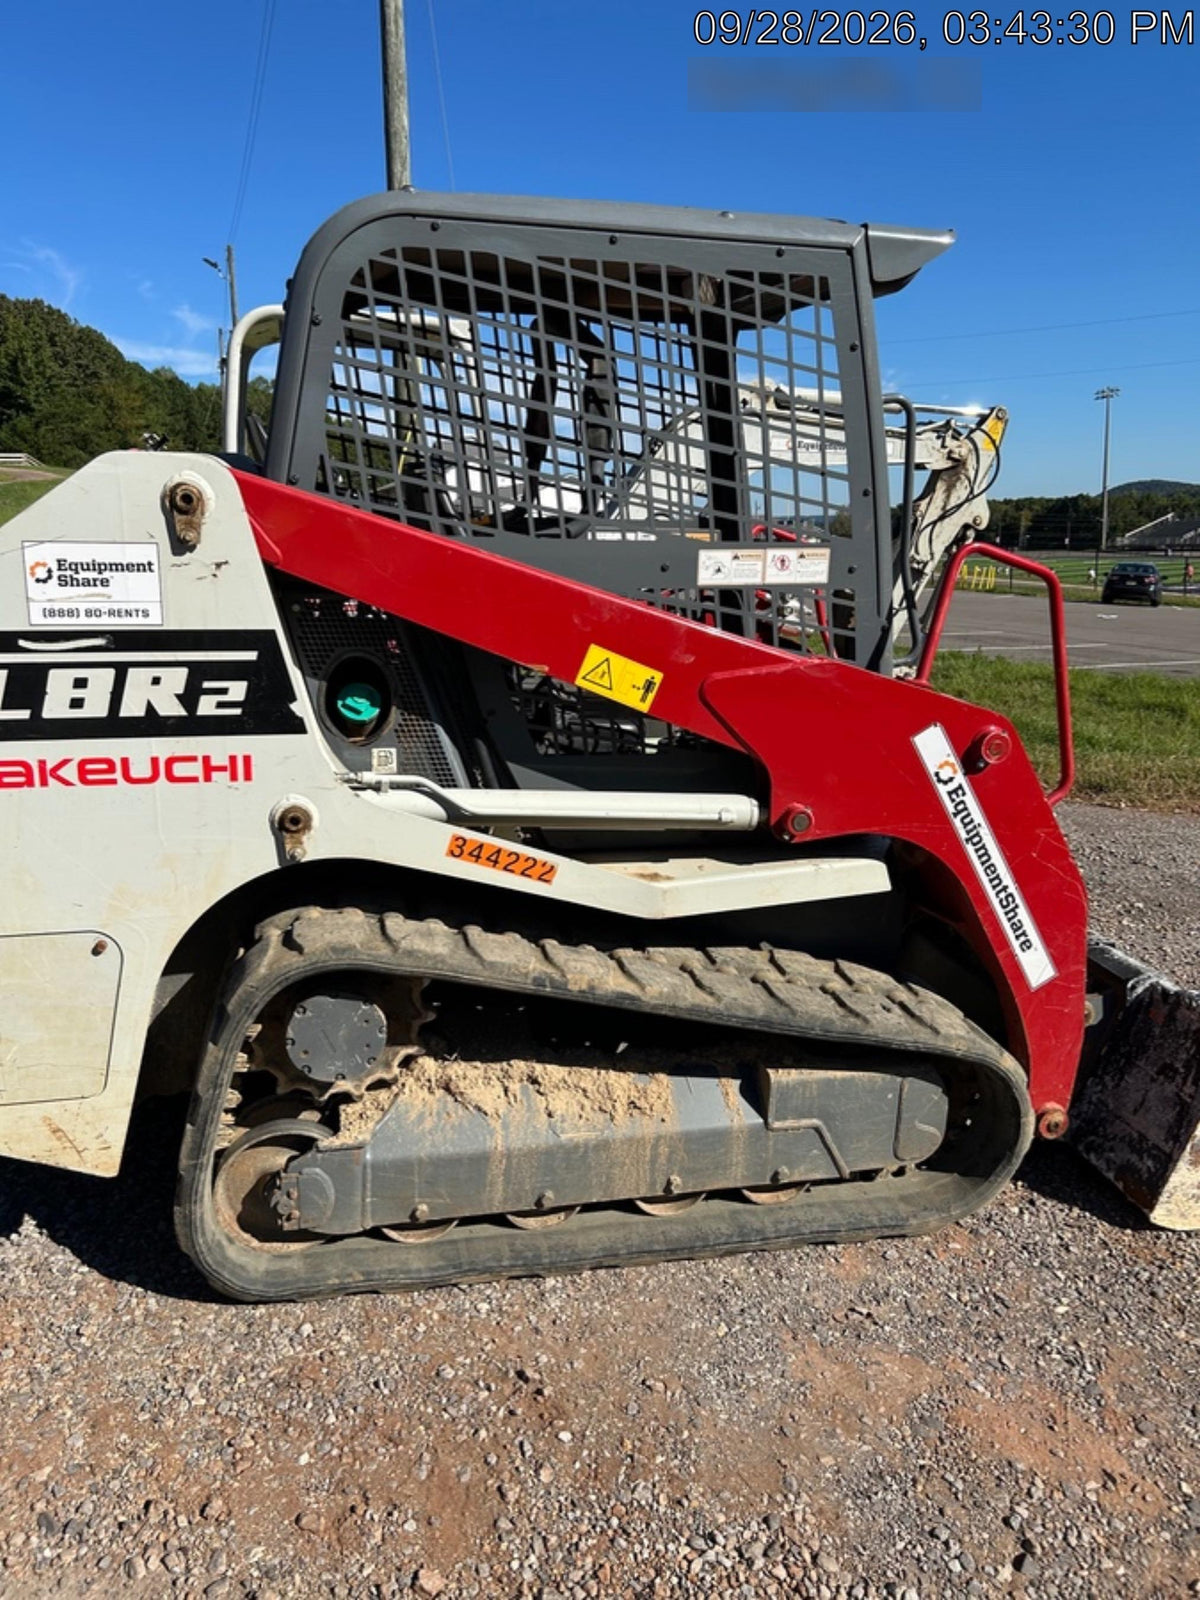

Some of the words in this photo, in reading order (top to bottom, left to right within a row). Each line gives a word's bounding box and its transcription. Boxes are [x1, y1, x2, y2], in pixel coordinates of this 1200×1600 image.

[56, 558, 155, 575] Equipment
[57, 573, 110, 588] Share
[42, 607, 80, 619] (888)
[84, 607, 150, 619] 80-RENTS
[449, 835, 556, 883] 344222
[946, 782, 1034, 953] EquipmentShare
